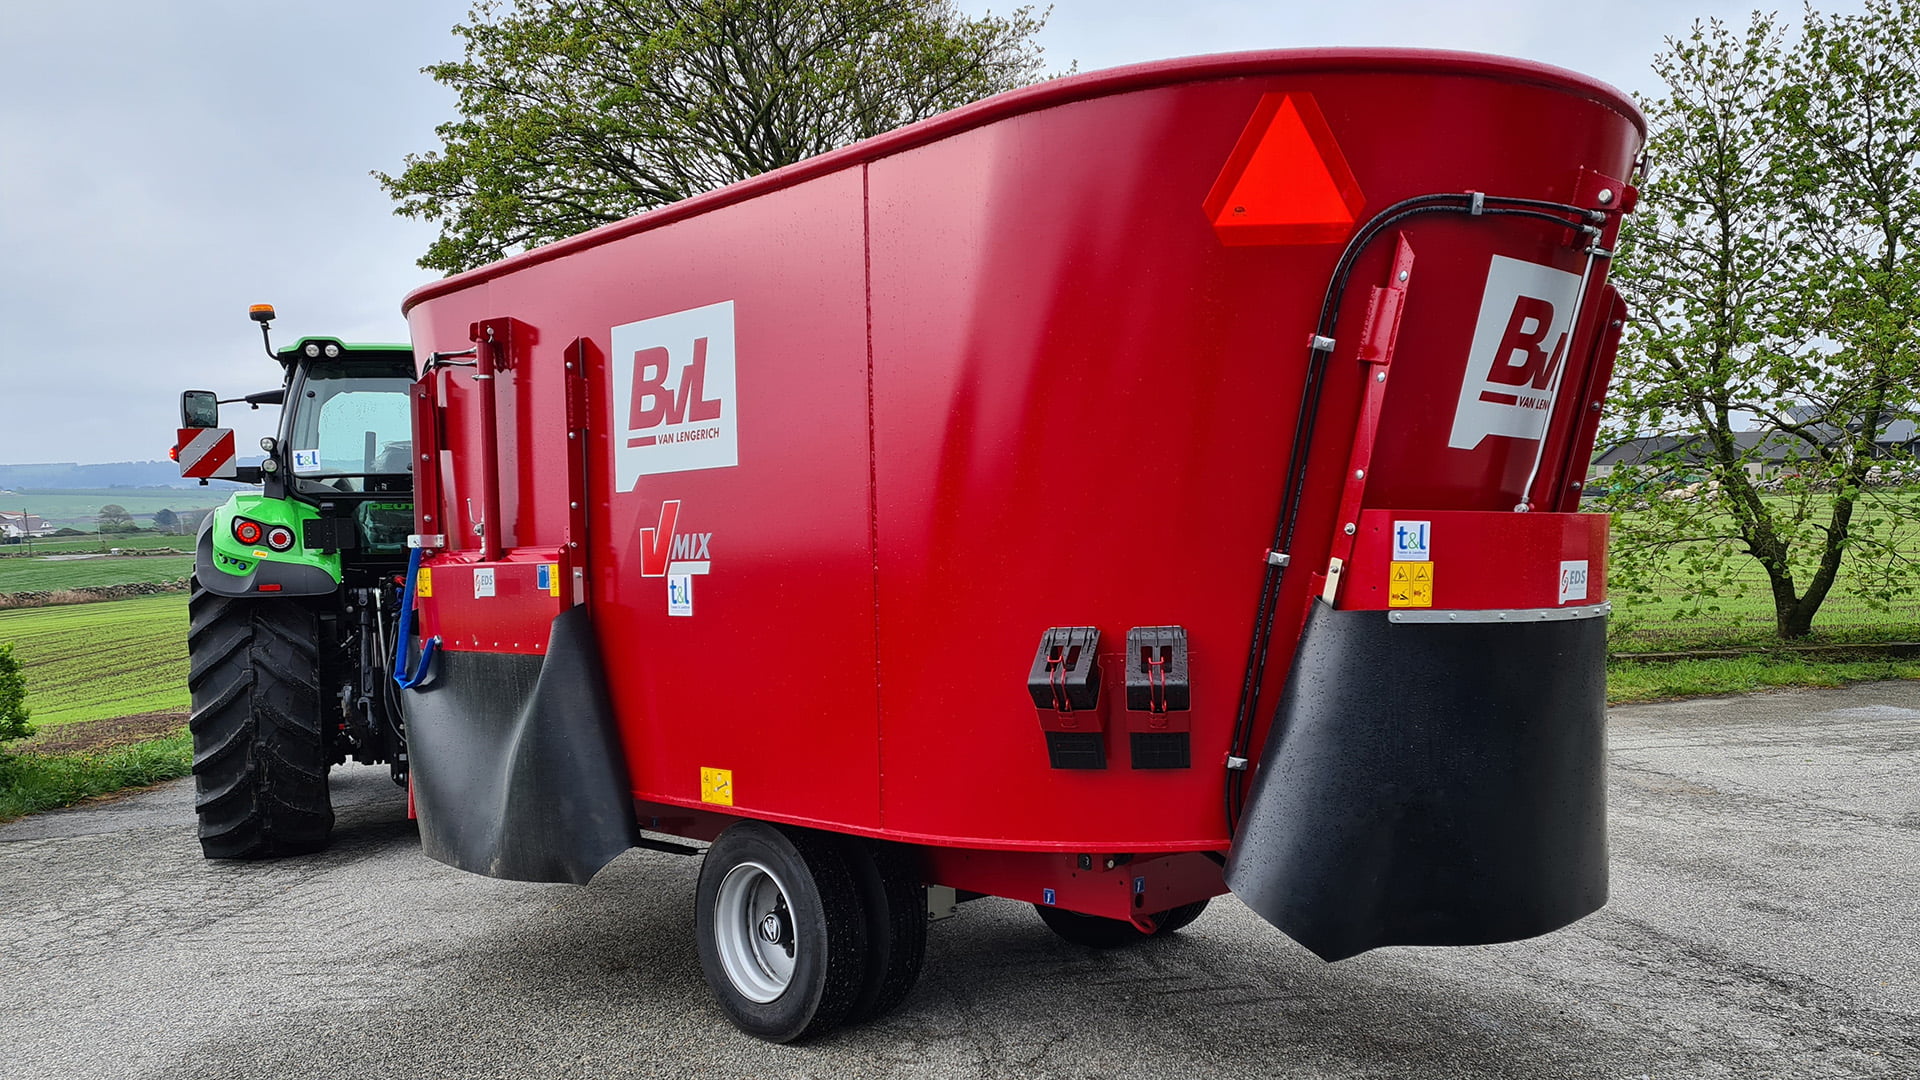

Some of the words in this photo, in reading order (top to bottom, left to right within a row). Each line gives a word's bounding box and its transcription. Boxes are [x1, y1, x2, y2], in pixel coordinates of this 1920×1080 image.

[1486, 296, 1568, 392] Bv
[1519, 396, 1536, 409] VAN
[658, 433, 674, 445] VAN
[676, 427, 720, 443] LENGERICH
[1397, 524, 1426, 550] t&l
[481, 575, 493, 586] EDS
[1569, 570, 1586, 585] EDS
[670, 577, 690, 605] t&l
